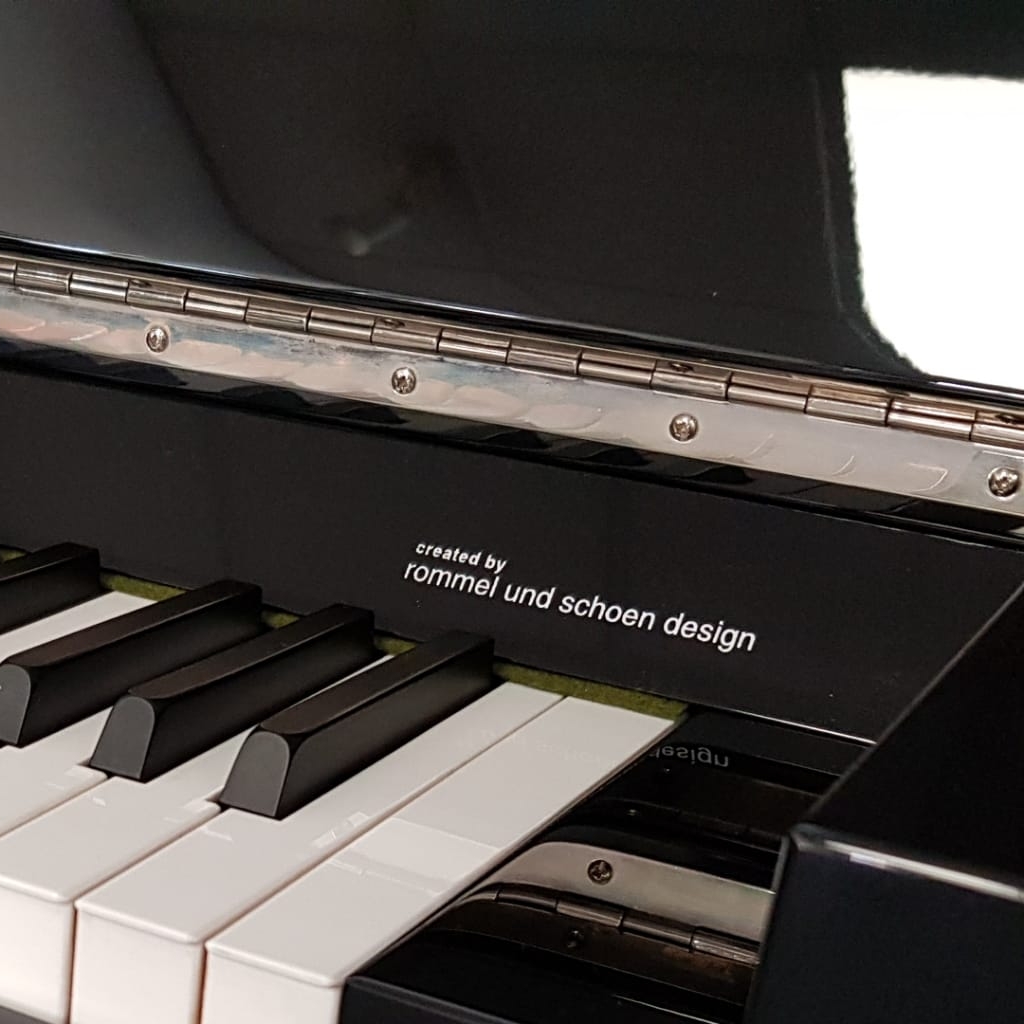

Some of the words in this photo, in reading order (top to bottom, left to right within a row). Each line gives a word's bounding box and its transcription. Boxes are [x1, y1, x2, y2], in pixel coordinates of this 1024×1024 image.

[415, 543, 482, 566] created
[484, 553, 507, 575] by
[403, 562, 500, 598] rommel
[503, 583, 557, 610] und
[558, 595, 656, 631] schoen
[663, 612, 756, 653] design
